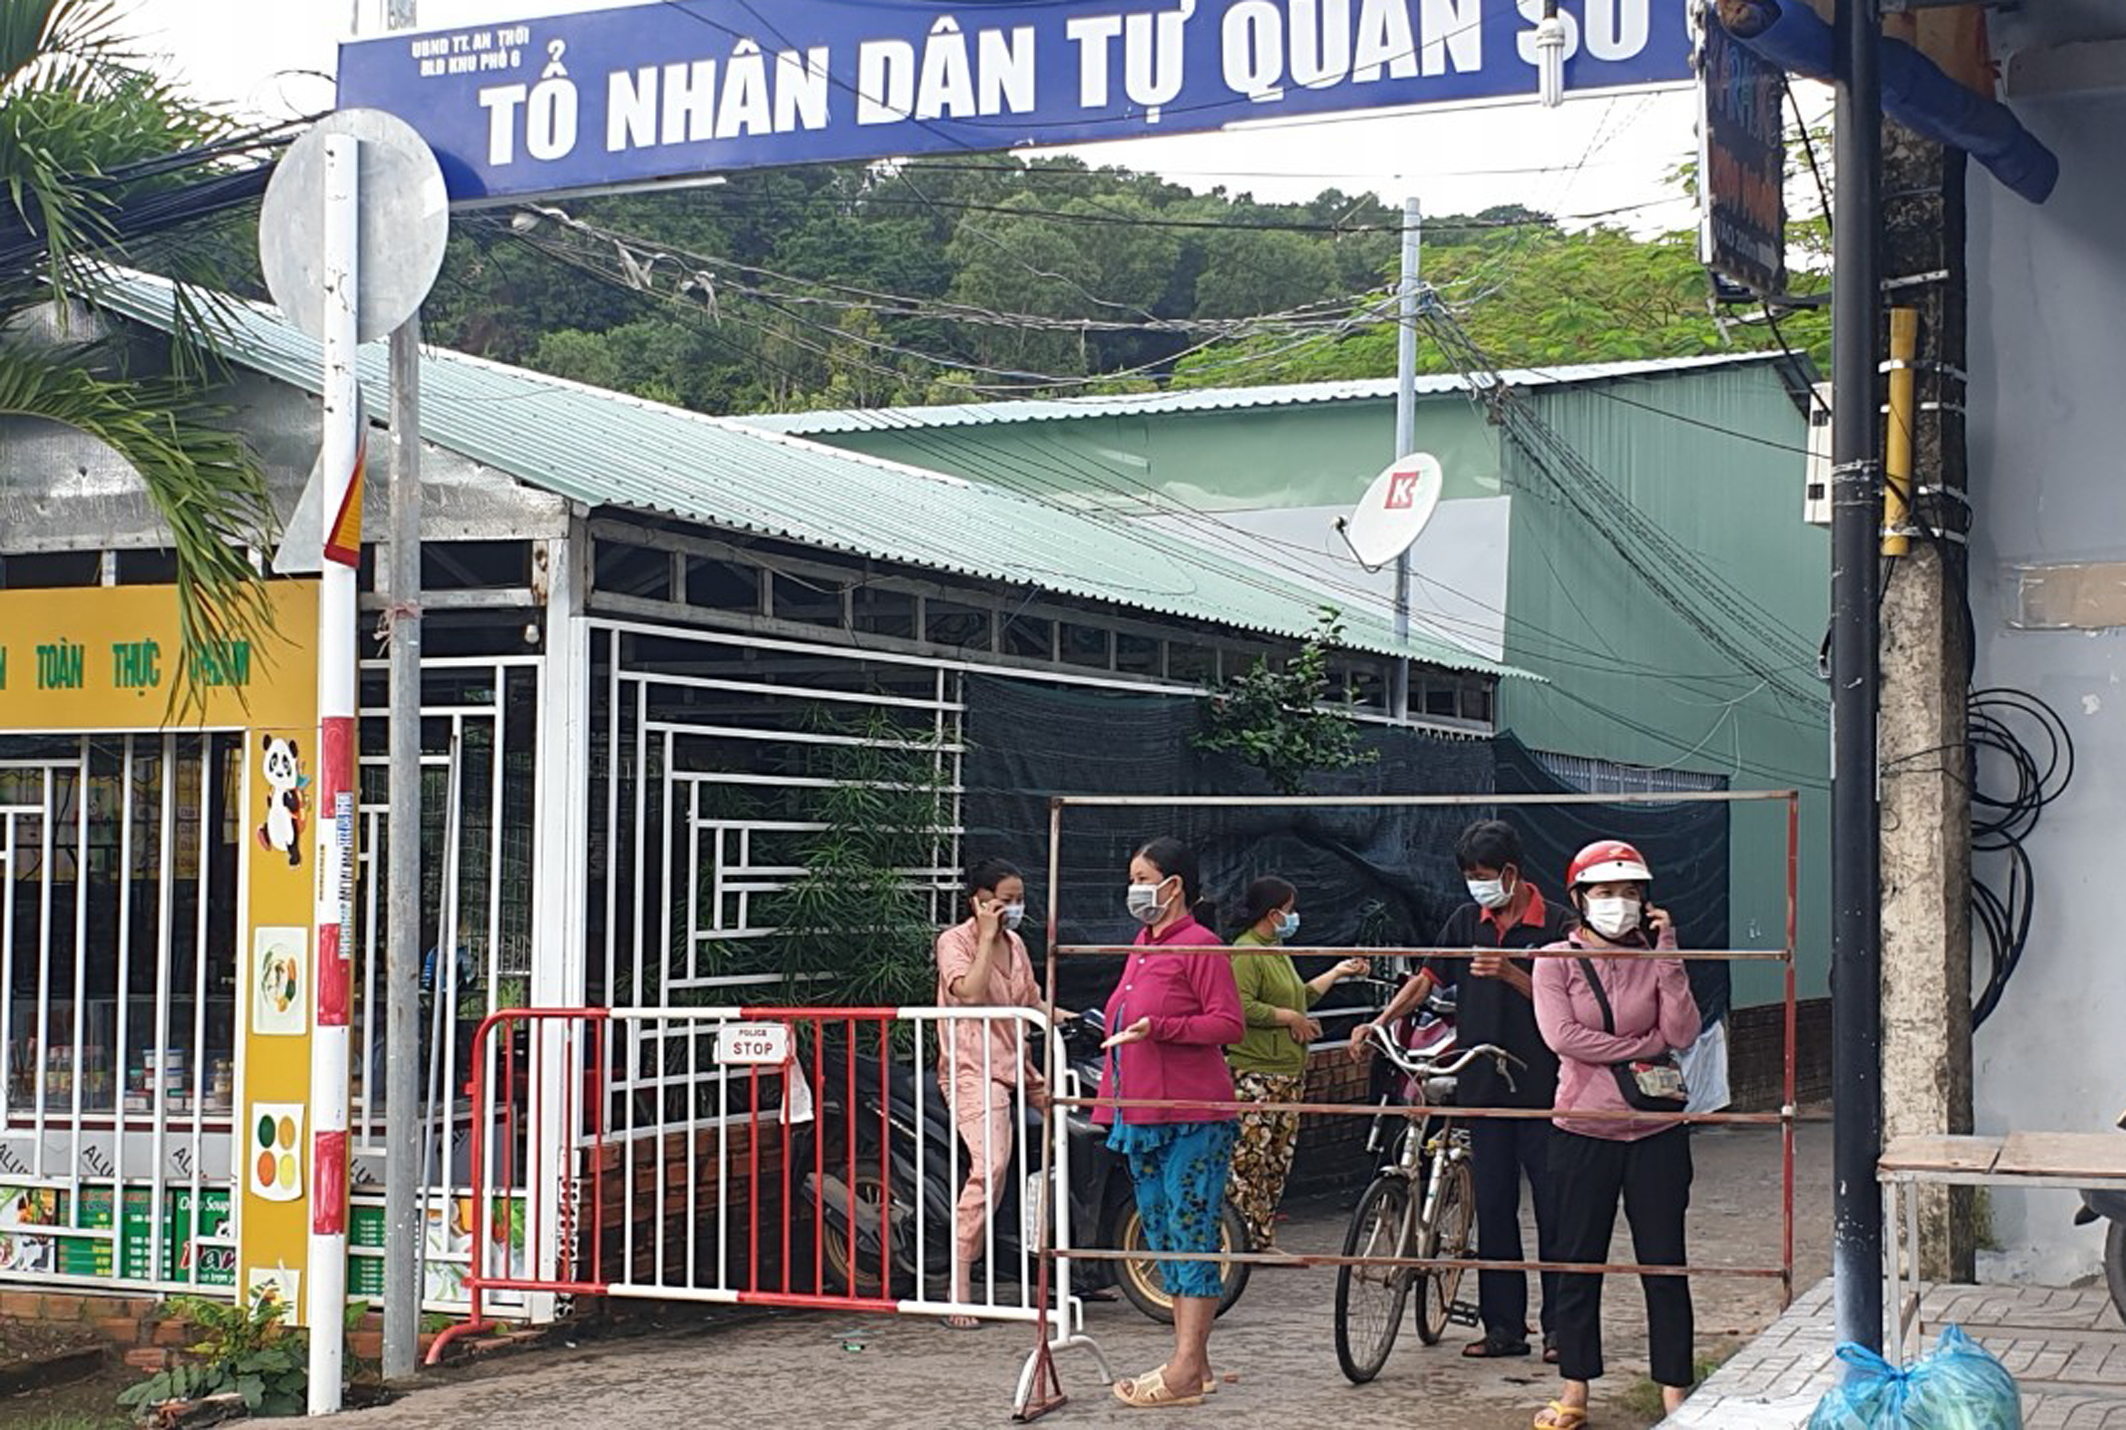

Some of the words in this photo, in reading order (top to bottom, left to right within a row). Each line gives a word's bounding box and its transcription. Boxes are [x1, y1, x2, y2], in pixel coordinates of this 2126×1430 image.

[479, 39, 578, 166] TỔ
[606, 39, 830, 152] NHÂN
[857, 14, 1036, 125] DÂN
[1066, 0, 1196, 123] TỰ
[35, 637, 86, 690] TOÀN
[112, 637, 161, 697] THỰC
[733, 1041, 773, 1056] STOP
[739, 1028, 768, 1038] POLICE
